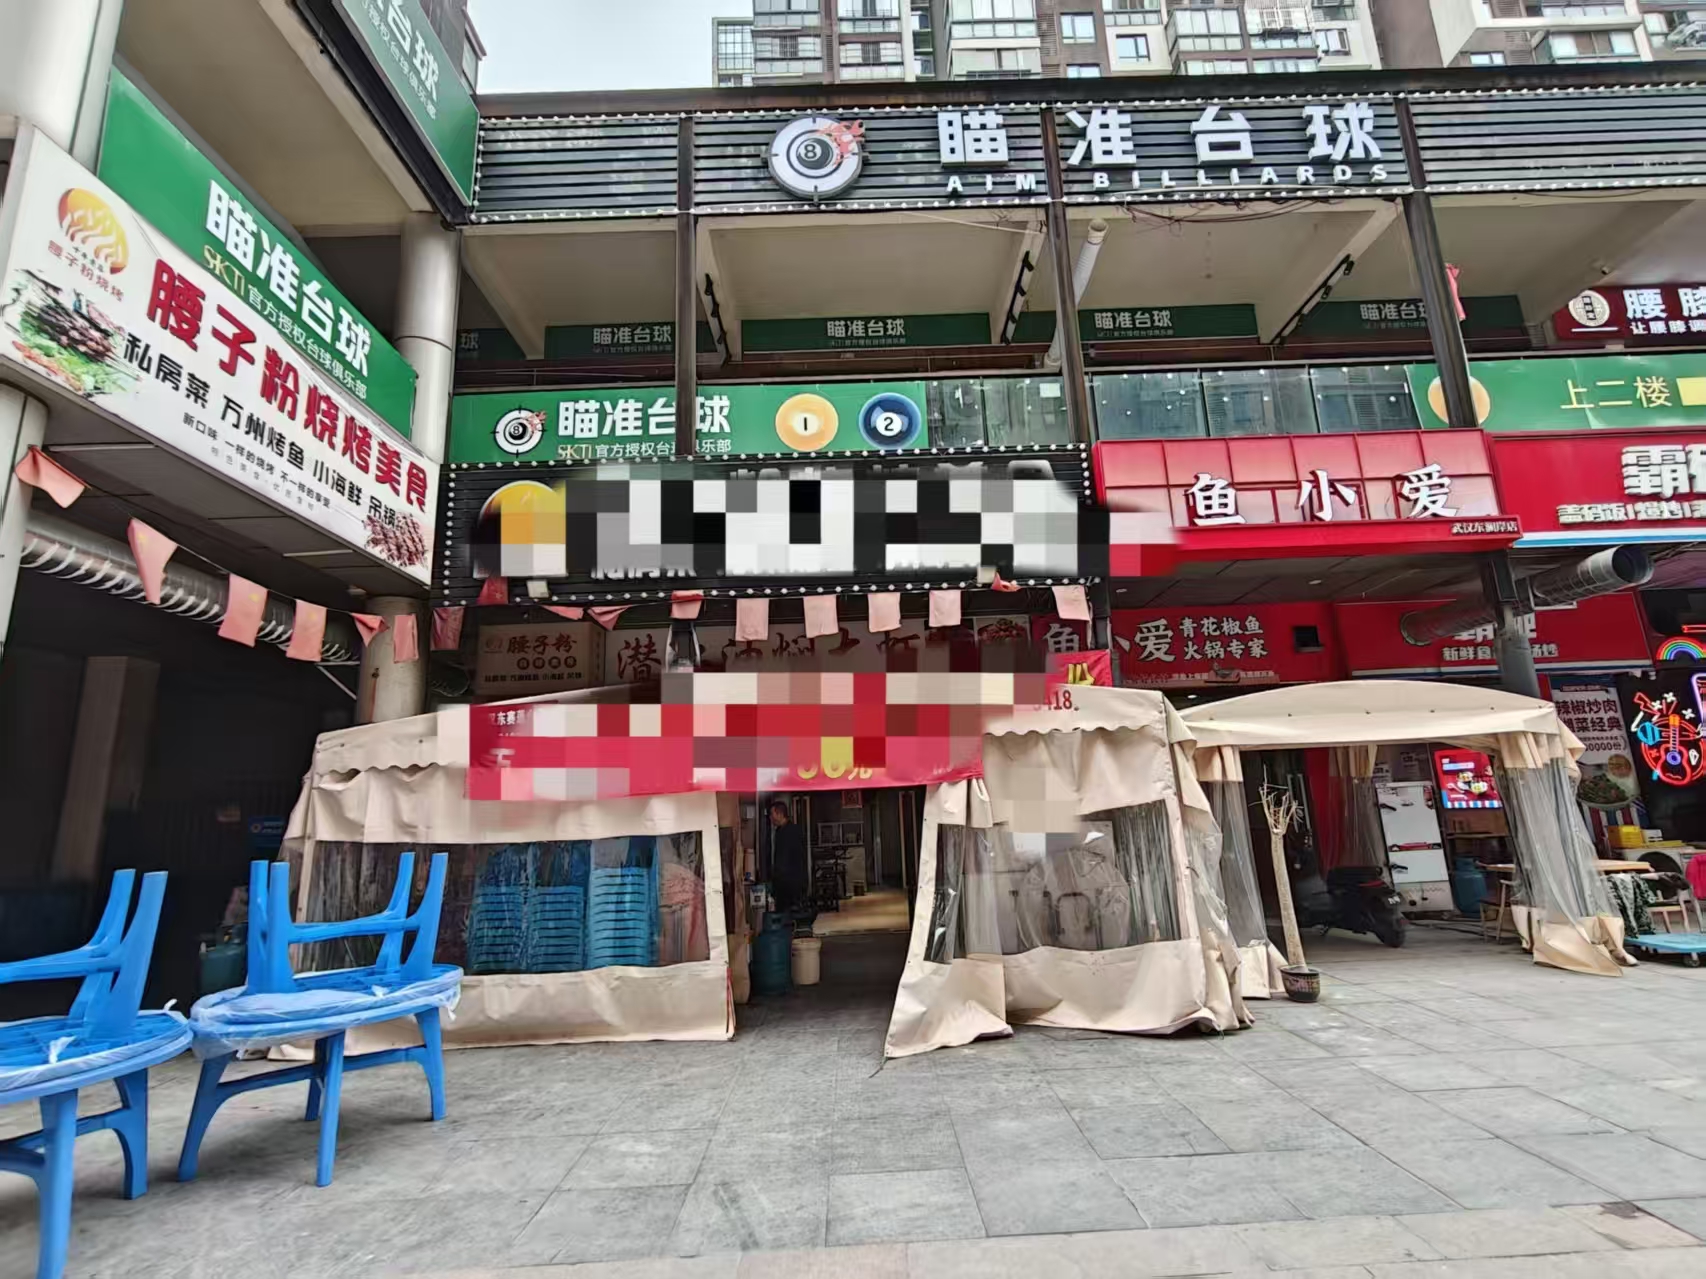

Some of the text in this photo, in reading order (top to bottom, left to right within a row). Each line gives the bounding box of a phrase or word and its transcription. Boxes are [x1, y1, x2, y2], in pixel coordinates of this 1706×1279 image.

[377, 0, 439, 102] 台球
[937, 102, 1382, 167] 瞄准台球
[803, 143, 819, 160] 8
[946, 163, 1389, 193] AIM BILLIARDS
[205, 179, 372, 378] 瞄准台球
[826, 317, 906, 338] 瞄准台球
[1094, 309, 1173, 329] 瞄准台球
[247, 283, 368, 400] 官方授权台球俱乐部
[592, 325, 672, 345] 瞄准台球
[146, 258, 428, 514] 腰子粉烧烤美食
[1559, 375, 1673, 409] 上二楼
[123, 331, 211, 409] 私房菜
[219, 394, 305, 471] 万州烤鱼
[312, 457, 363, 507] 小海鲜
[182, 411, 219, 441] 新口味
[558, 394, 731, 439] 瞄准台球
[883, 415, 895, 432] 2
[594, 438, 732, 459] 官方授权台乐部
[1187, 462, 1459, 528] 鱼小爱
[1179, 615, 1264, 638] 青花椒鱼
[1183, 637, 1269, 660] 火锅专家
[1555, 698, 1618, 716] 辣椒炒肉
